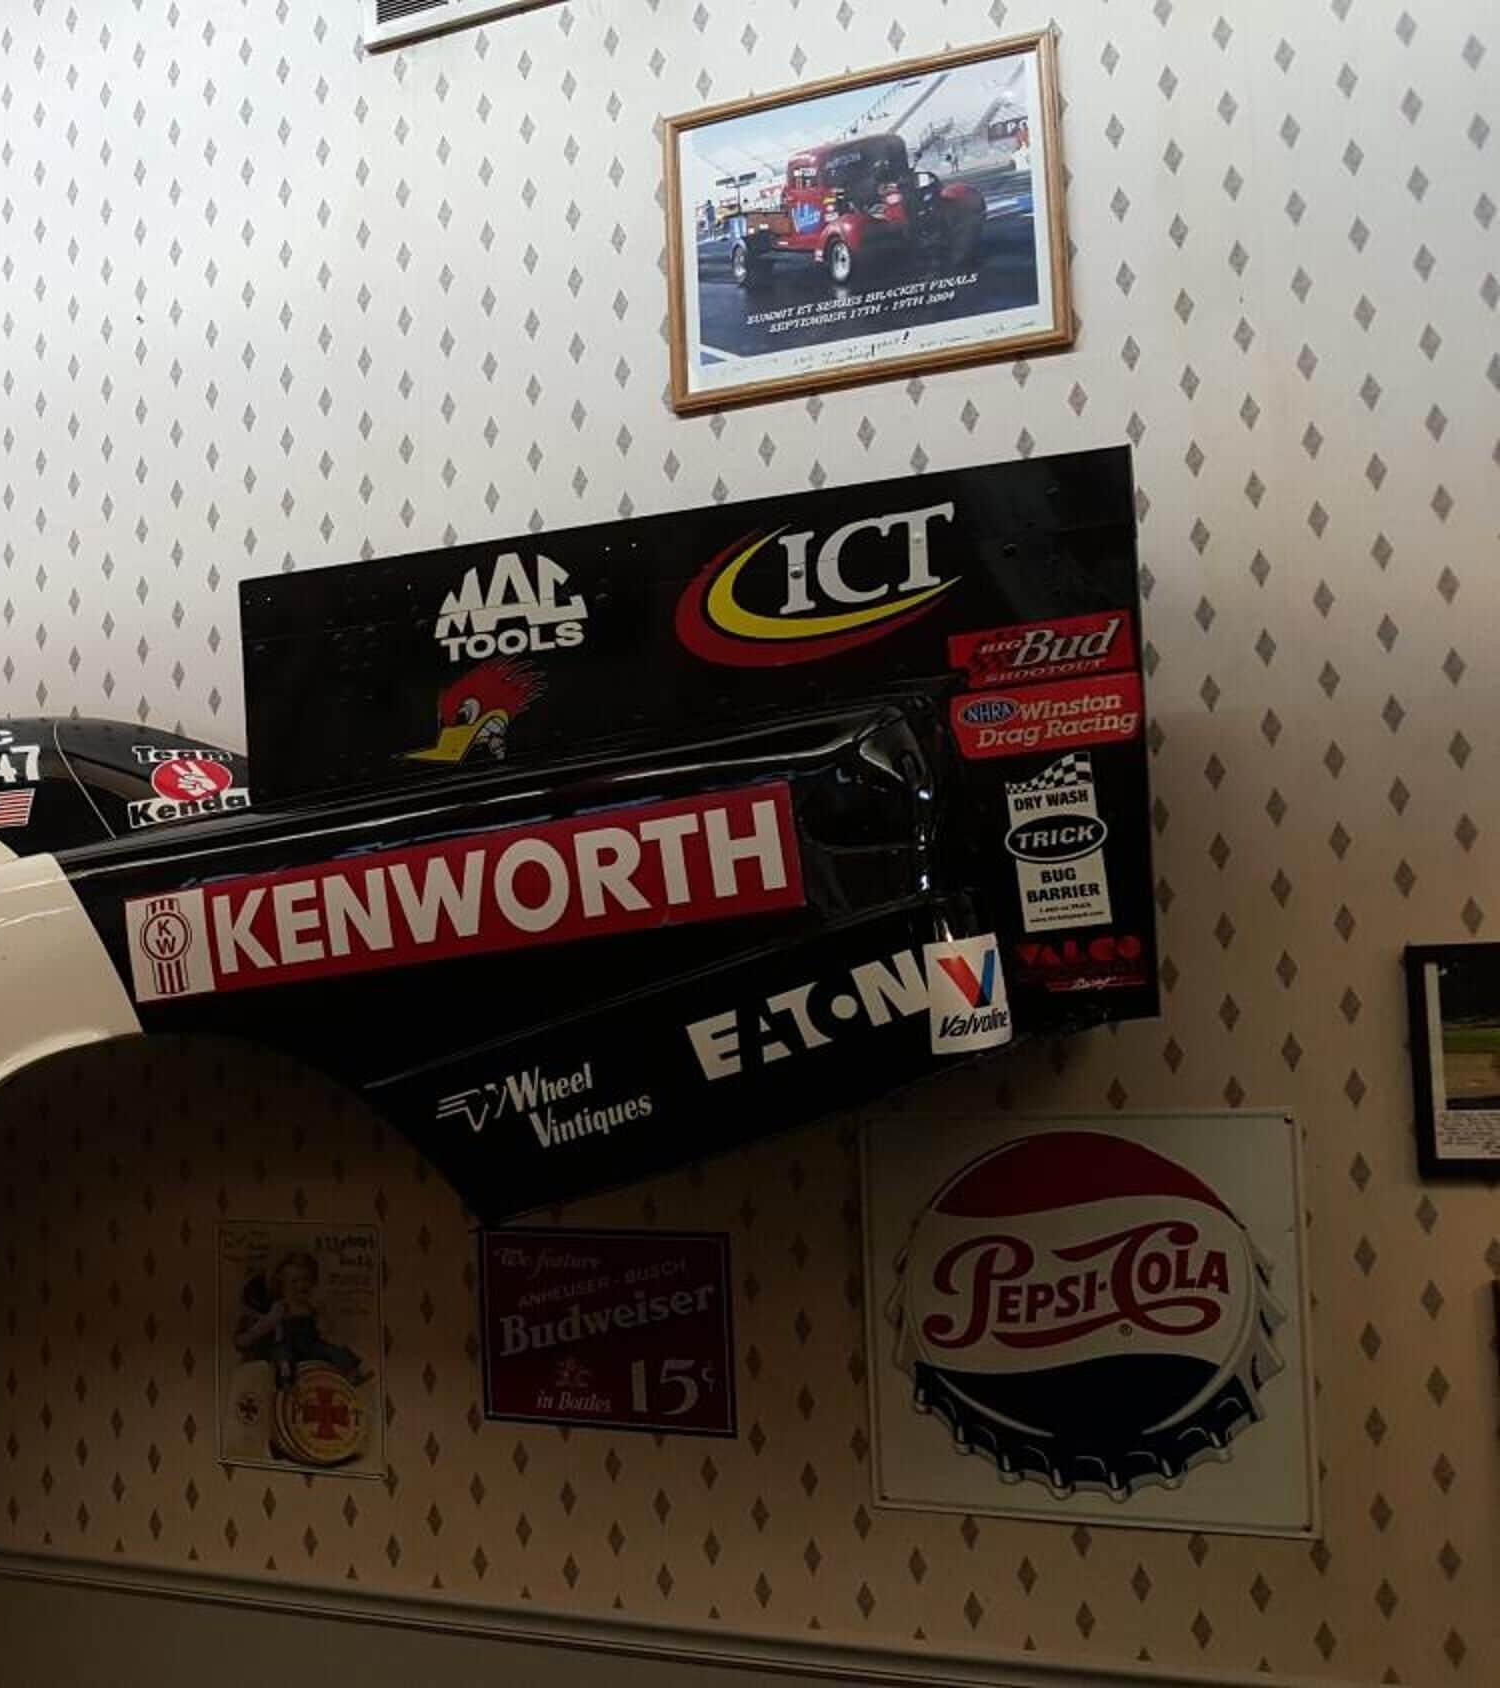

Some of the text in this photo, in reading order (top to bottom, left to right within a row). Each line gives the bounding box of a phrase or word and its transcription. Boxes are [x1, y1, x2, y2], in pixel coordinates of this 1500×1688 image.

[777, 501, 956, 616] ICT
[435, 551, 588, 639] MAC
[440, 621, 586, 663] TOOLS
[1012, 618, 1122, 668] Bud
[966, 694, 1122, 722] NHRA Winston
[975, 712, 1139, 748] Drag Racing
[132, 746, 233, 763] Team
[127, 788, 251, 829] Kenda
[1013, 789, 1090, 812] DRY WASH
[1015, 824, 1095, 850] TRICK
[212, 798, 789, 976] KENWORTH
[1026, 882, 1100, 903] BARRIER
[1040, 867, 1077, 884] BUG
[938, 1007, 1008, 1038] Valvoline
[505, 1061, 593, 1114] Wheel
[529, 1093, 653, 1149] Vintiques
[500, 1282, 717, 1358] Budweiser
